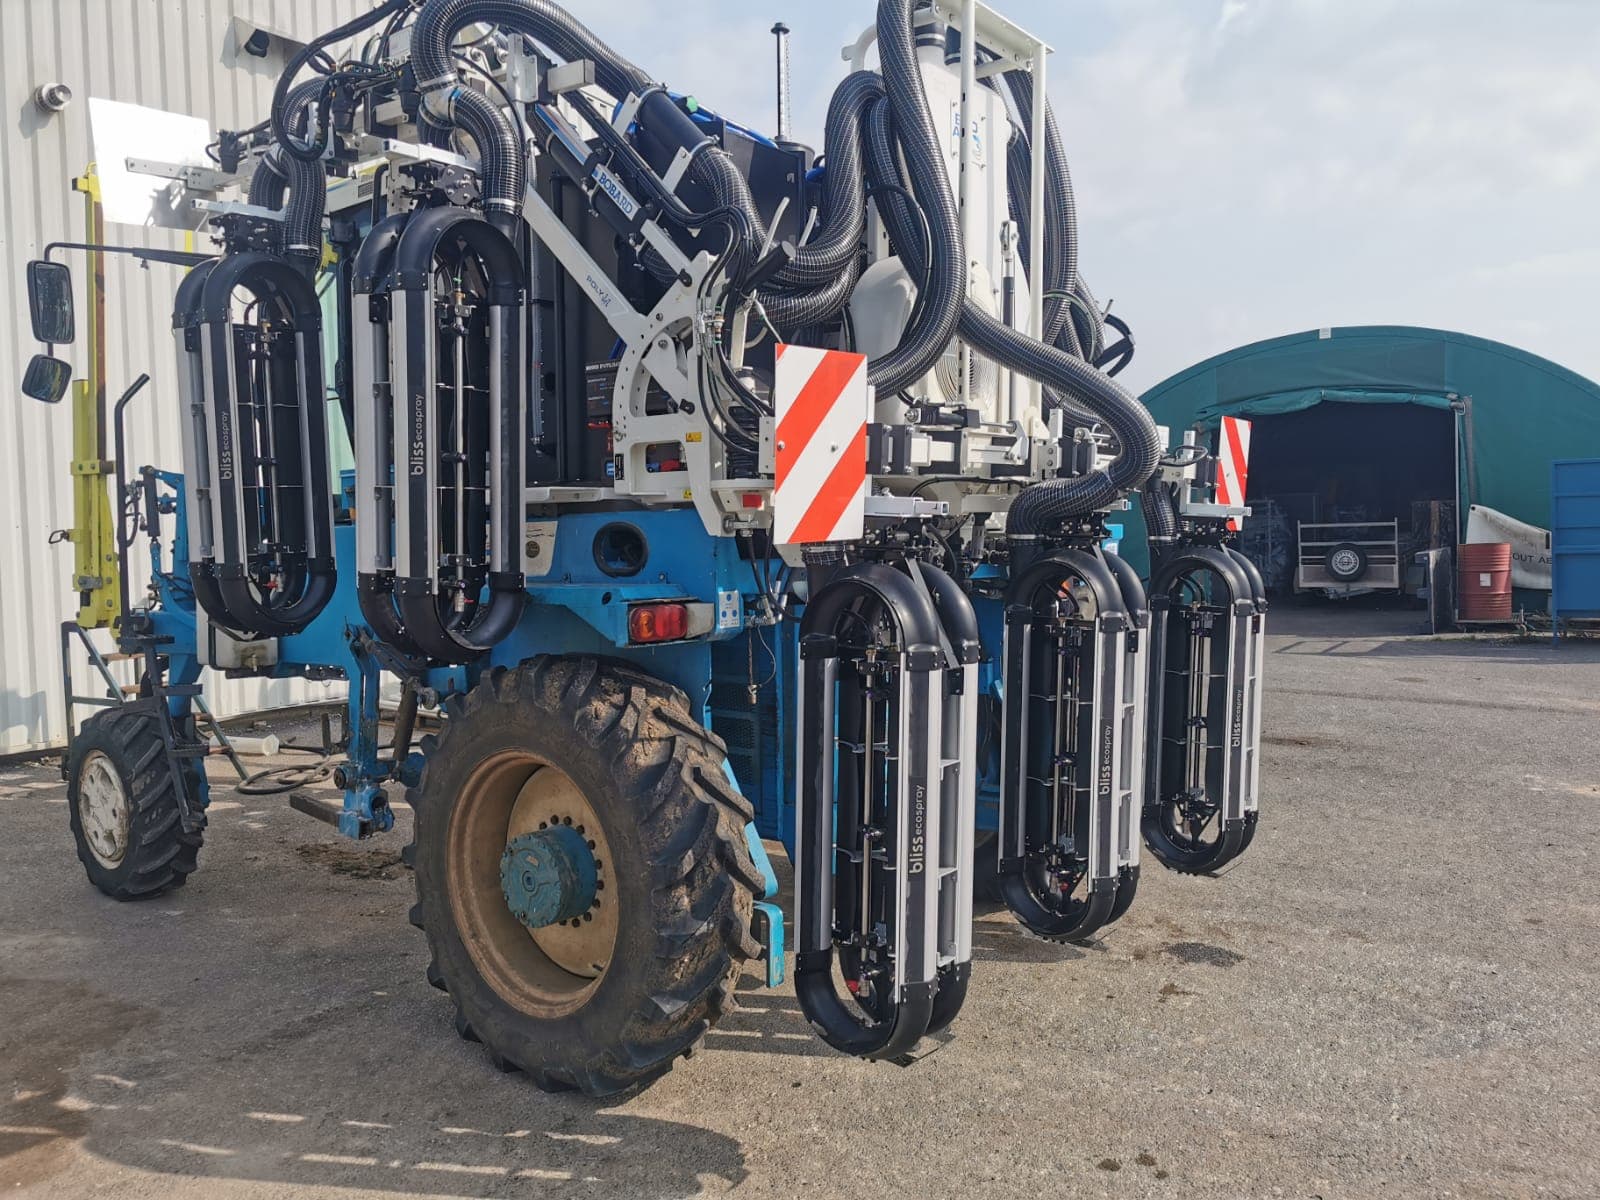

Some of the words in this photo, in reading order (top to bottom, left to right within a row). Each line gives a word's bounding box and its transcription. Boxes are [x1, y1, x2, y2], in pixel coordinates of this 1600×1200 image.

[599, 172, 633, 213] BOBARD
[221, 411, 230, 450] ecospray
[415, 394, 424, 440] ecospray
[220, 450, 232, 480] bliss
[409, 441, 424, 476] bliss
[1104, 725, 1112, 765] ecospray
[1231, 722, 1241, 747] bliss
[1099, 766, 1111, 795] bliss
[915, 785, 925, 835] ecospray
[909, 836, 924, 873] bliss
